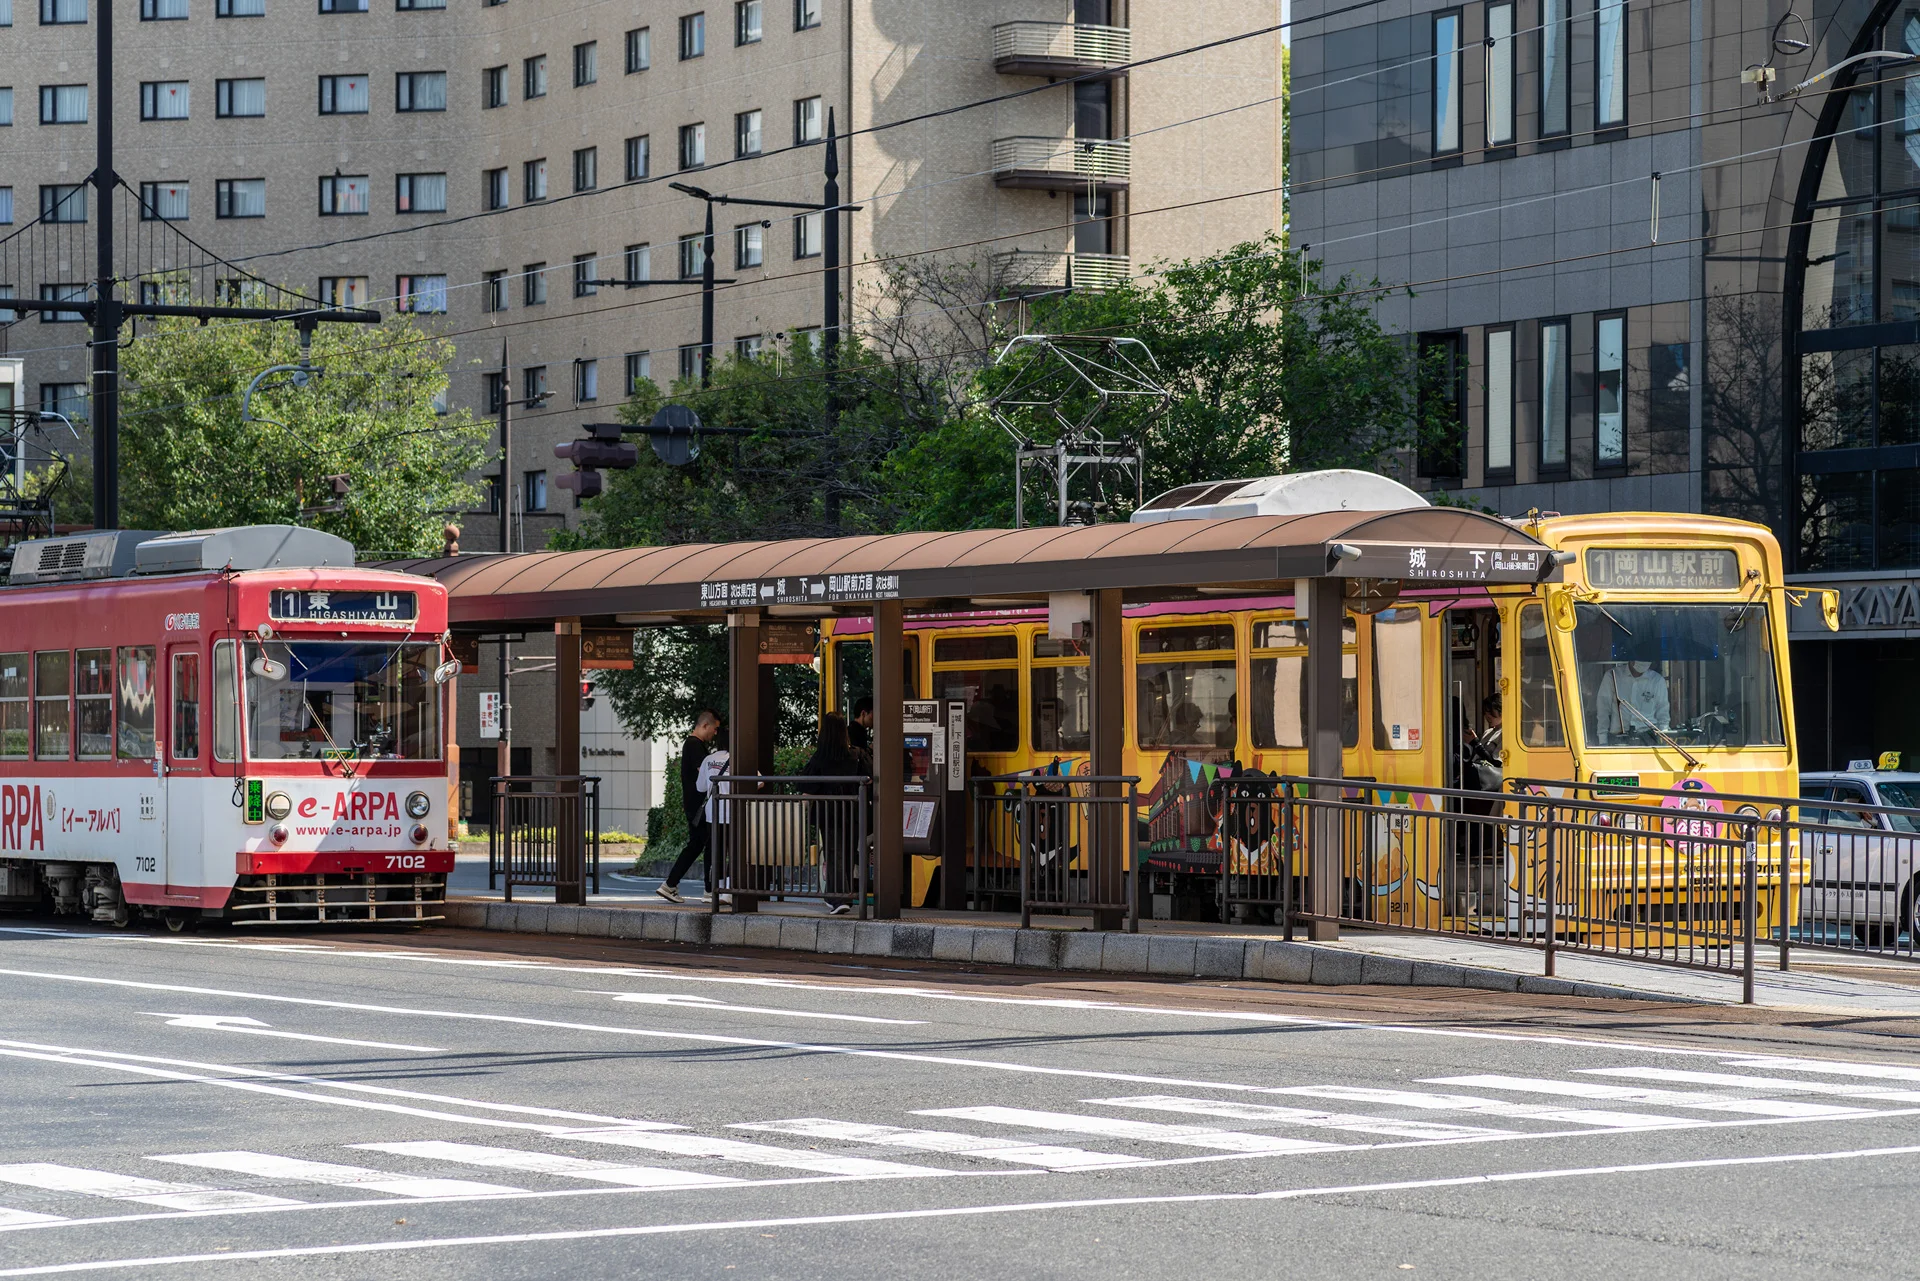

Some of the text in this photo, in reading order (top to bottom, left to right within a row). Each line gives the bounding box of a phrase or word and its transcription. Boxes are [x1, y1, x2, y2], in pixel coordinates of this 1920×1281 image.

[1409, 569, 1486, 579] SHIROSHITA
[1594, 551, 1724, 582] 1 岡山駅前
[828, 574, 873, 592] 岡山駅前方面
[1616, 575, 1724, 586] OKAYAMA-EKIMAE
[701, 582, 728, 600] 東山方面
[776, 595, 808, 604] SHIROSHITA
[828, 593, 840, 601] FOR
[845, 592, 873, 600] OKAYAMA
[284, 593, 294, 617] 1
[1820, 584, 1920, 626] KAYA
[309, 610, 397, 621] HIGASHIYAMA
[248, 780, 262, 821] 乗降中
[297, 791, 400, 821] e-ARPA
[296, 824, 402, 837] www.e-arpa.jp
[136, 856, 156, 873] 7102
[385, 855, 426, 869] 7102
